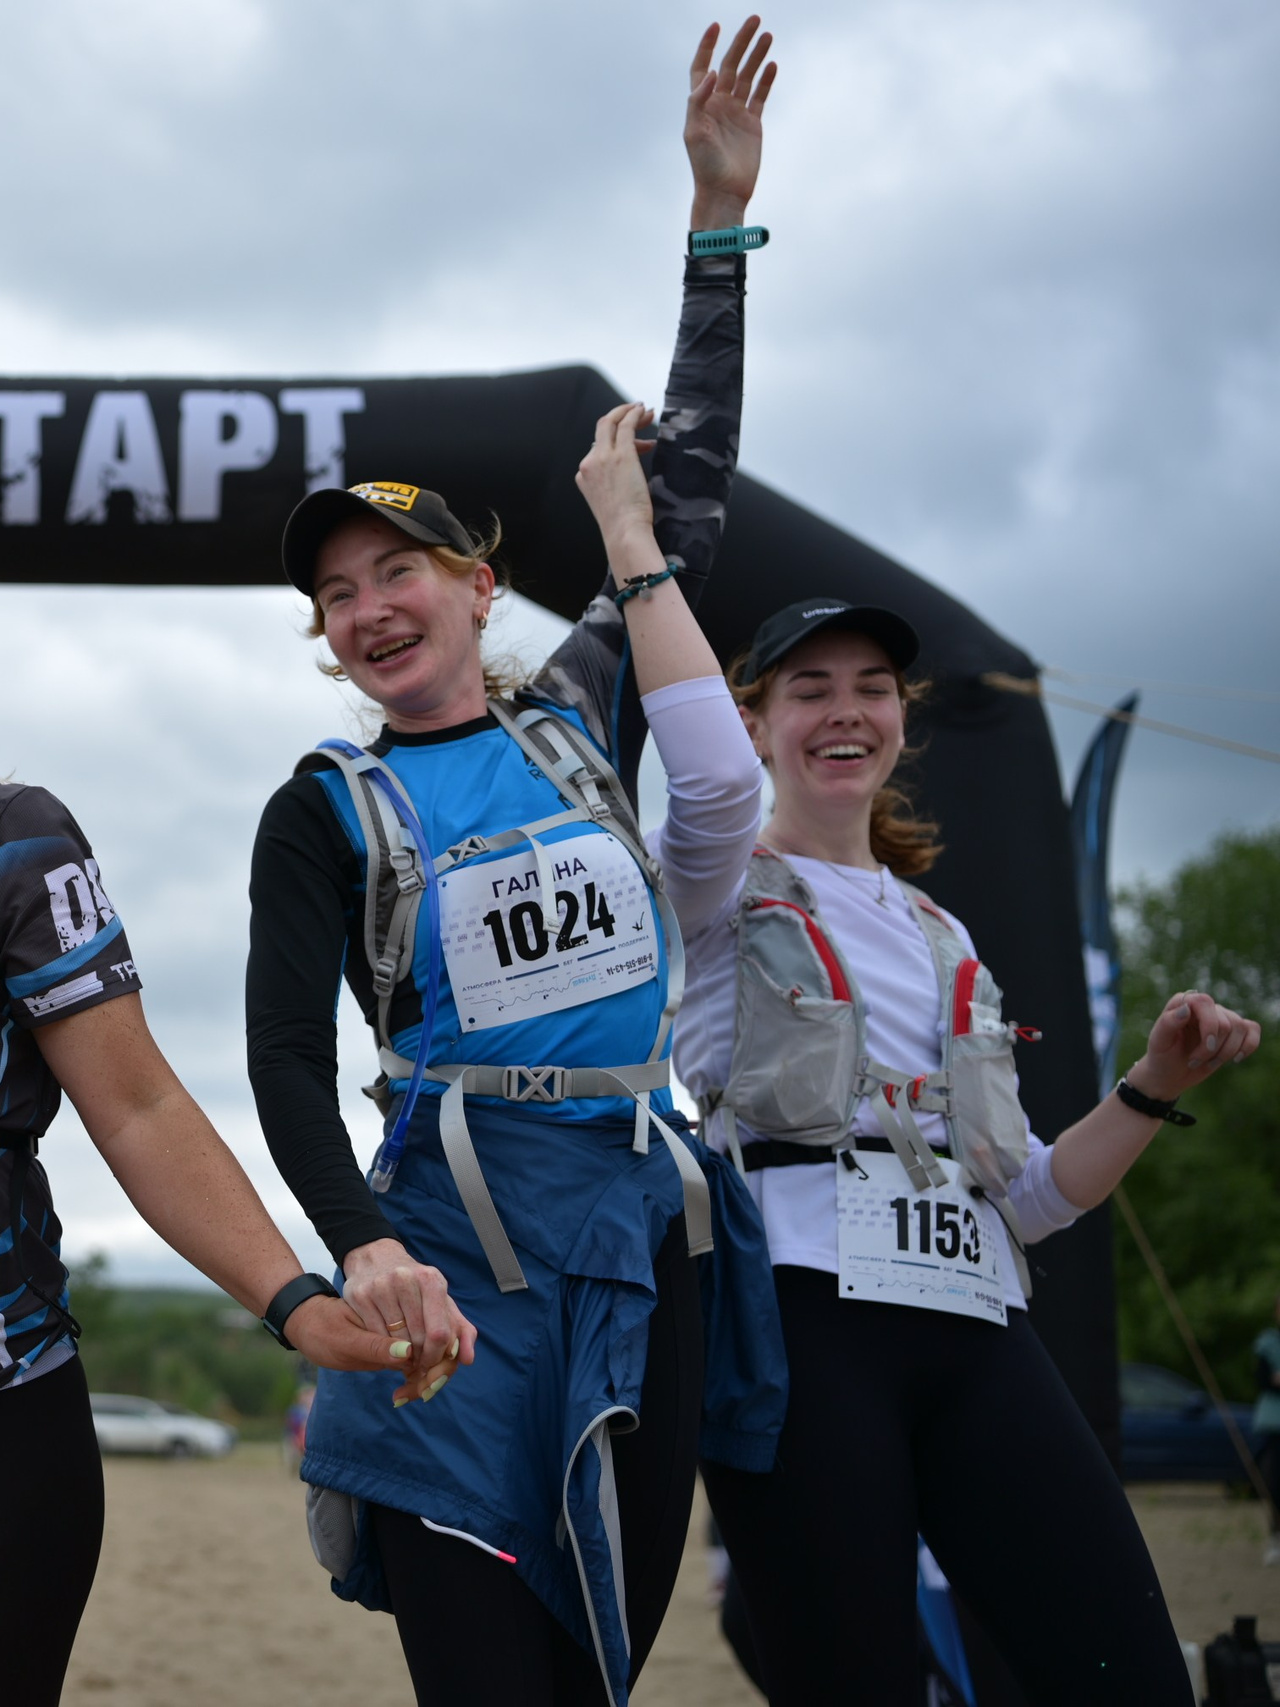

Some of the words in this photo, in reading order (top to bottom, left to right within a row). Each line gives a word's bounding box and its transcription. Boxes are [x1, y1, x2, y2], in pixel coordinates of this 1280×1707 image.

[483, 881, 616, 968] 1024
[462, 979, 502, 992] АТМОСФЕРА
[890, 1197, 981, 1264] 1153
